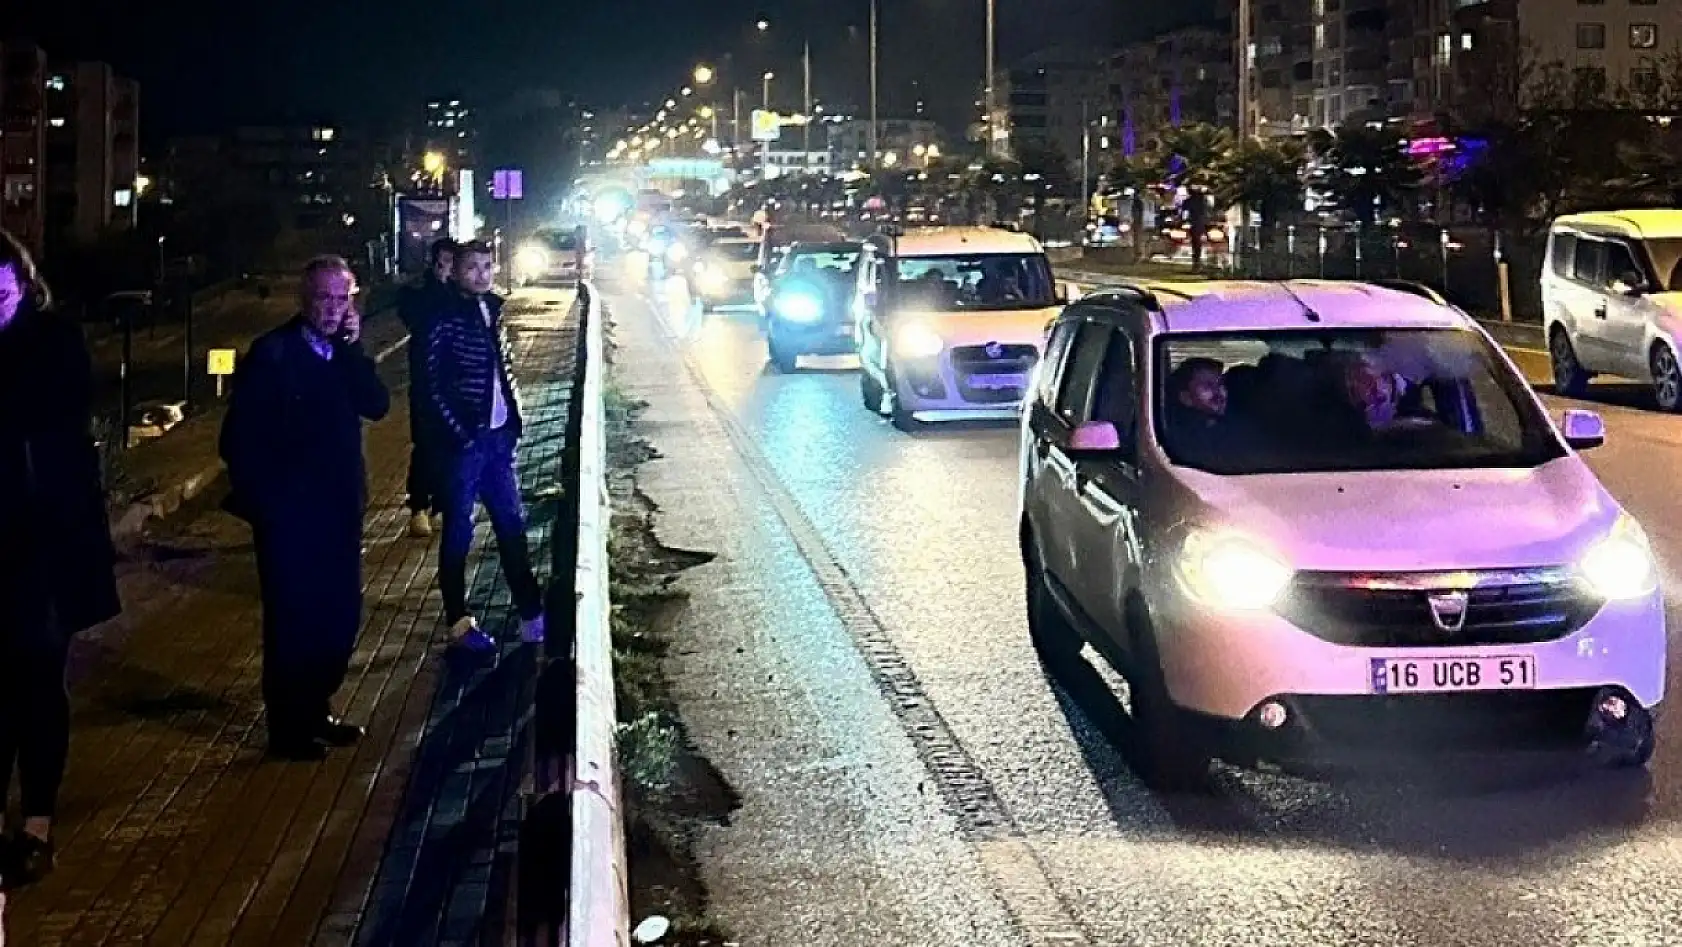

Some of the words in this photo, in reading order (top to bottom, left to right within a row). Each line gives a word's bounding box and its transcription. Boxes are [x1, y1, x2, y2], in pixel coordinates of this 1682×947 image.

[1391, 662, 1419, 687] 16
[1432, 661, 1481, 687] UCB
[1499, 660, 1528, 686] 51
